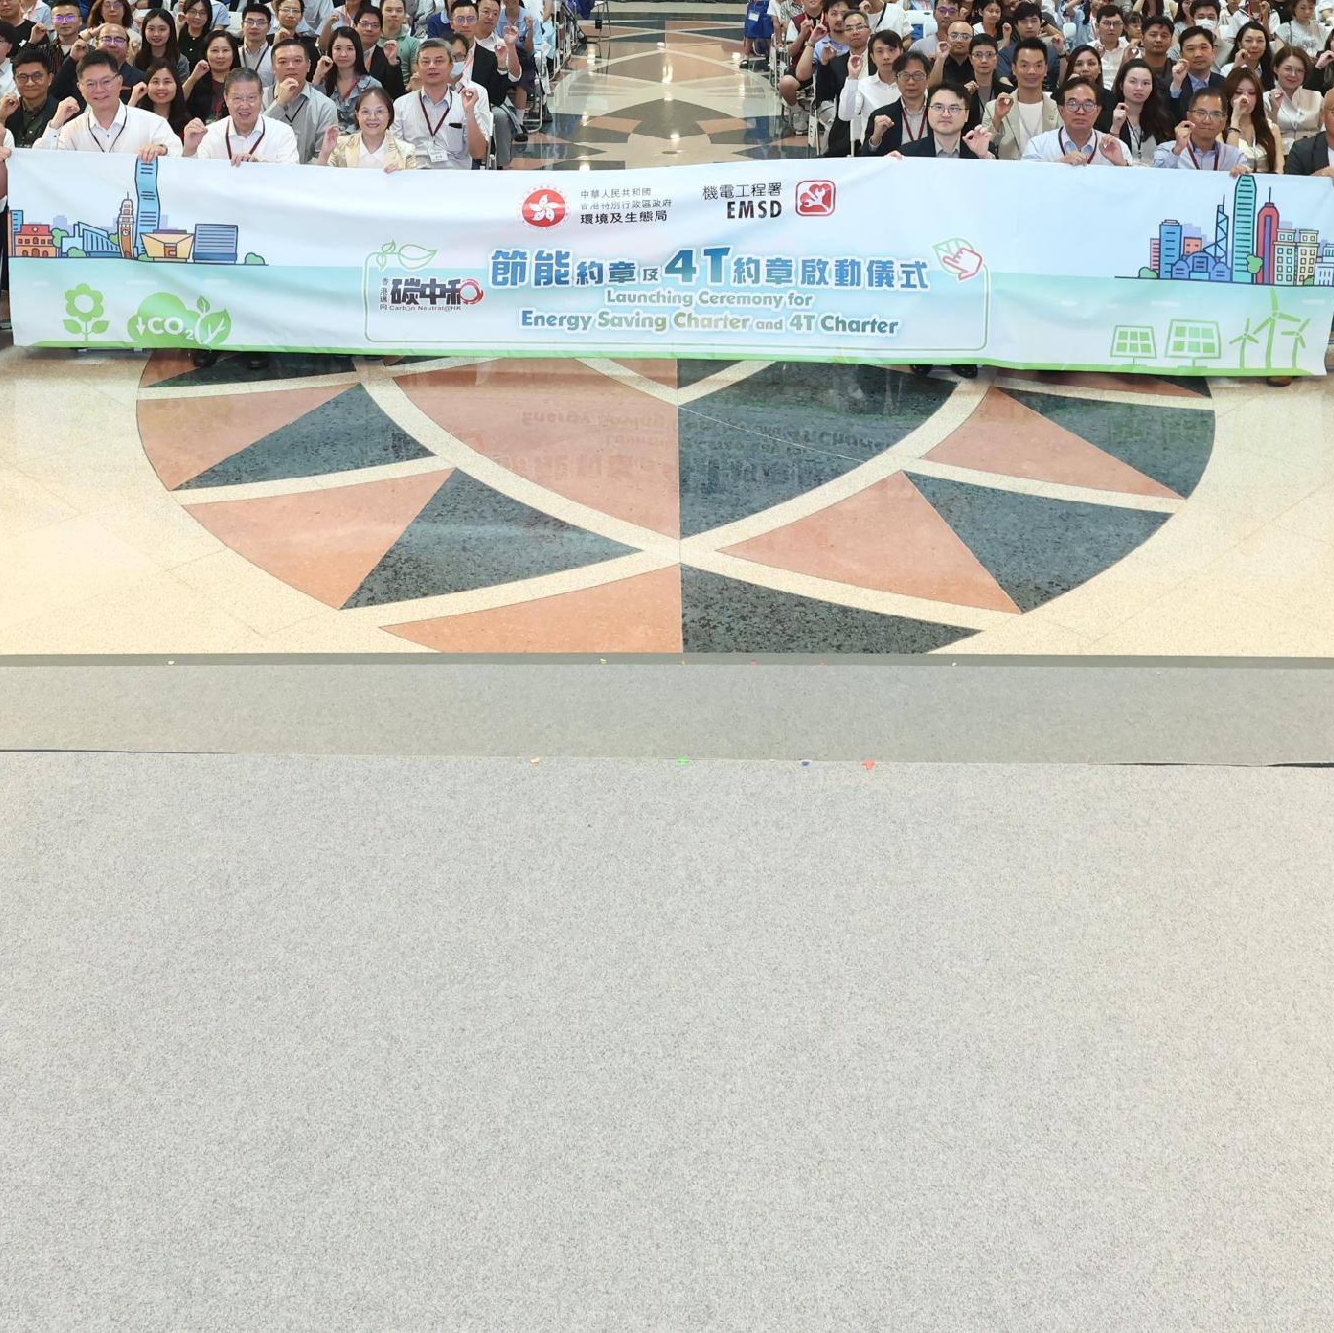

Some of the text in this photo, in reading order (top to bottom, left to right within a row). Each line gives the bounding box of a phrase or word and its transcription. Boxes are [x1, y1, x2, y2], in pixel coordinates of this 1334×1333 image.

[580, 187, 652, 199] 中華人民共和國
[702, 181, 782, 200] 機電工程署
[580, 209, 668, 225] 環境及生態局
[727, 200, 782, 219] EMSD
[390, 278, 483, 306] 碳中和
[607, 289, 814, 309] Launching Ceremony for
[521, 310, 899, 334] Energy Saving Charter and 4T Charter
